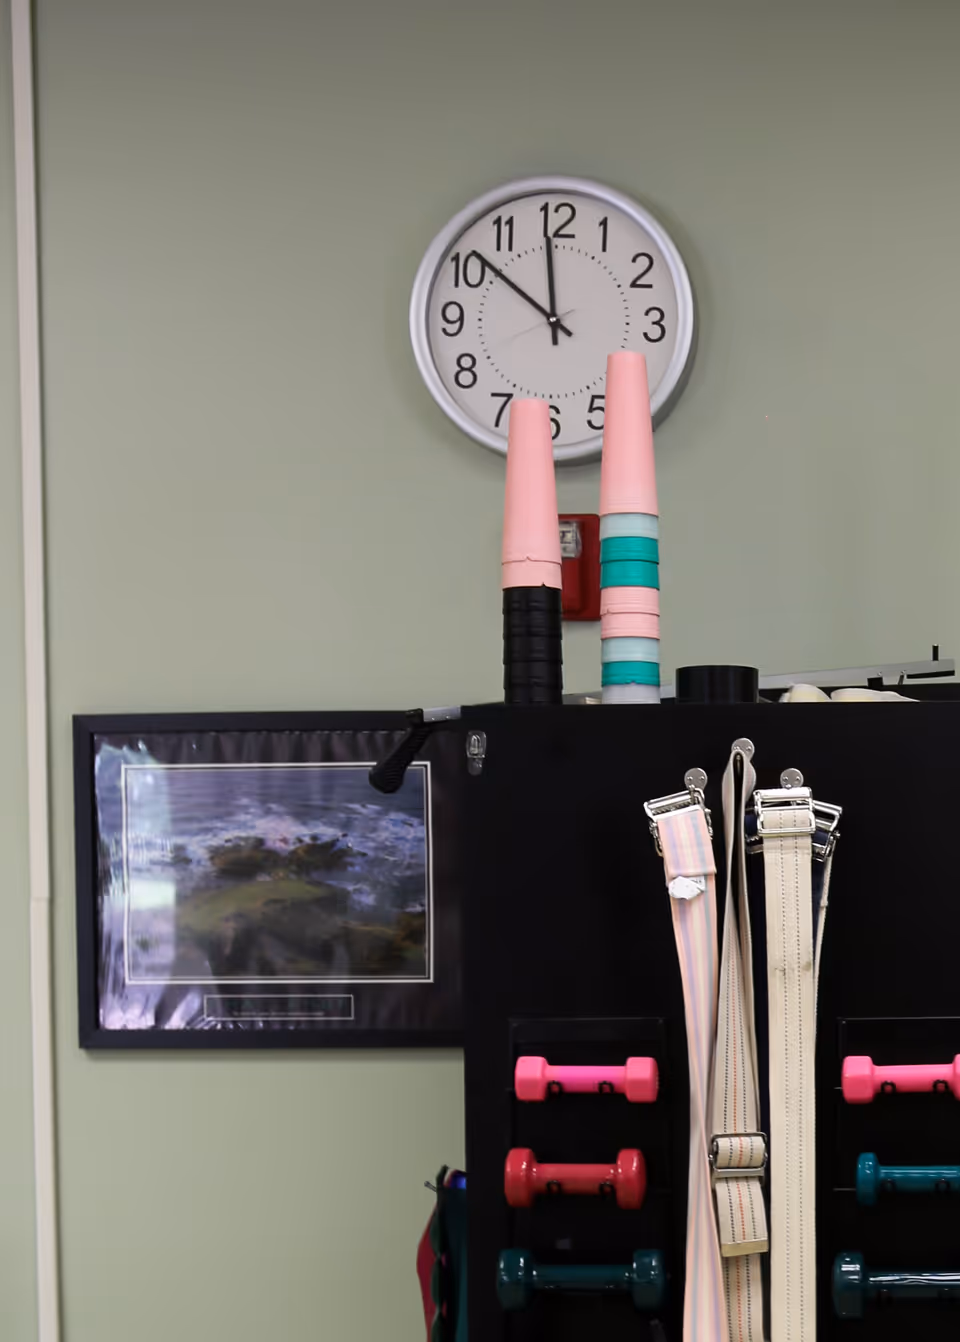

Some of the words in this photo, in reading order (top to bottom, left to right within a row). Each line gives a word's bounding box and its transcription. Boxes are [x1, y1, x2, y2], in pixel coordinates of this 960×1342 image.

[492, 215, 515, 252] 11
[539, 202, 577, 239] 12
[598, 216, 609, 253] 1
[450, 250, 487, 289] 10
[629, 252, 655, 289] 2
[440, 301, 465, 337] 9
[642, 307, 667, 343] 3
[453, 353, 478, 389] 8
[490, 392, 514, 428] 7
[586, 394, 606, 431] 5
